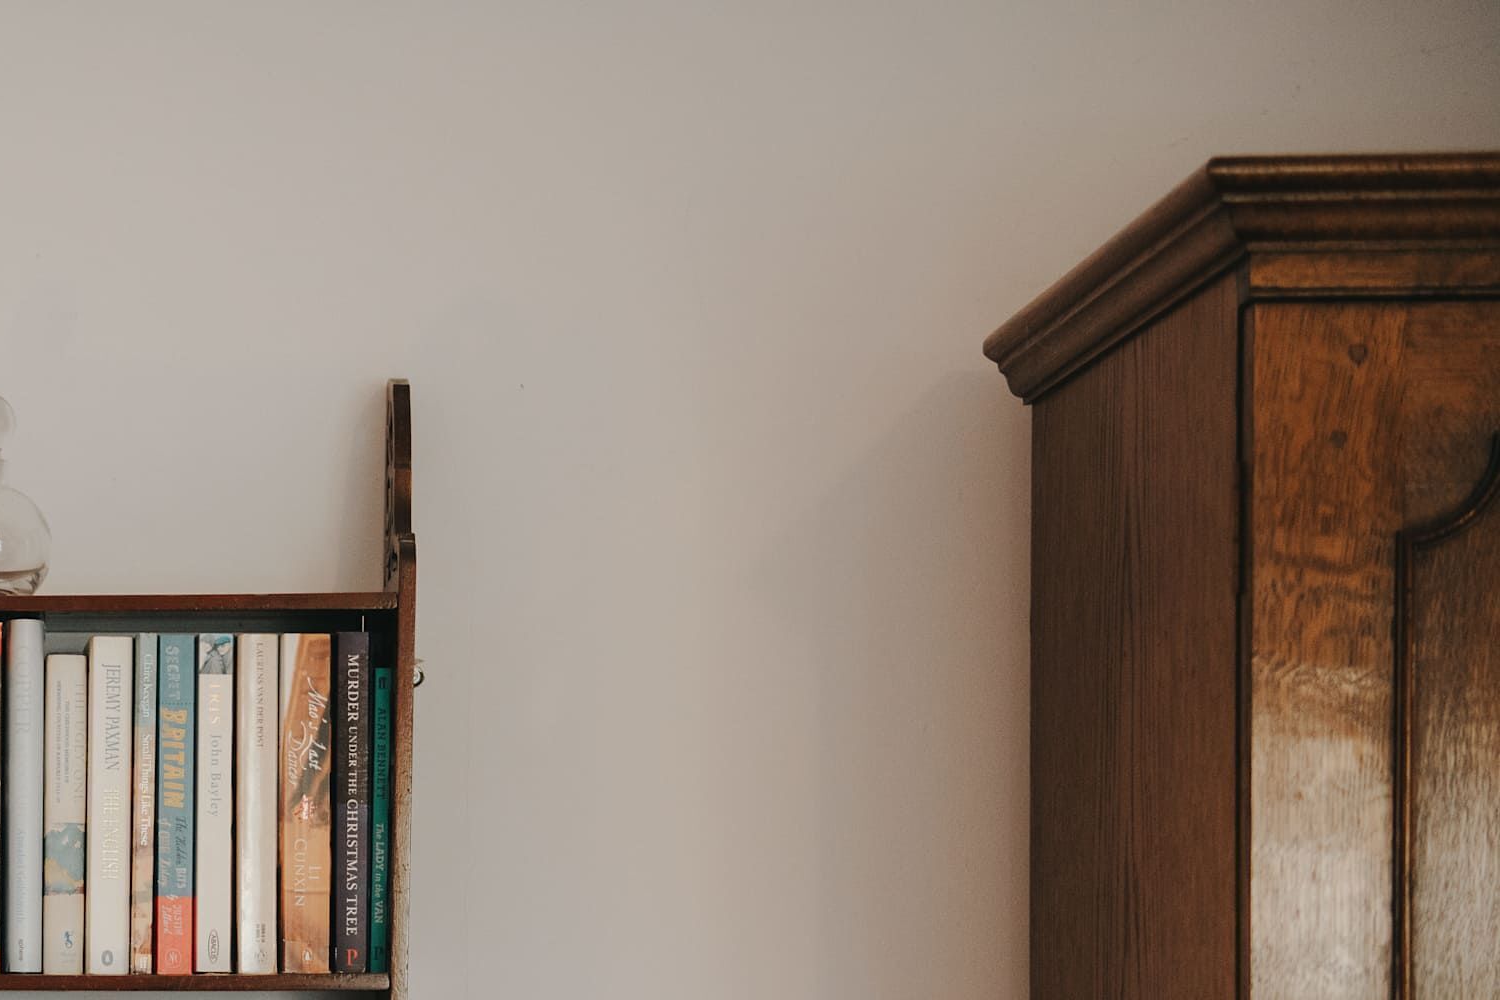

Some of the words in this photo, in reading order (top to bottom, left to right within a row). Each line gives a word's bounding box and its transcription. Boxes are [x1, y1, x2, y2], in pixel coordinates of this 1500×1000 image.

[143, 654, 153, 683] Claire
[165, 646, 181, 702] SECRET
[256, 642, 264, 685] LAURENS
[101, 664, 121, 712] JEREMY
[140, 684, 152, 718] Keegan
[256, 687, 264, 704] VAN
[307, 677, 328, 732] Mao's
[346, 654, 360, 721] MURDER
[255, 725, 263, 748] POST
[376, 708, 387, 740] ALAN
[104, 716, 119, 770] PAXMAN
[141, 734, 153, 761] Small
[161, 709, 188, 809] BRITAIN
[208, 734, 222, 768] John
[287, 731, 308, 787] Dancer
[308, 736, 325, 770] Last
[348, 725, 358, 768] UNDER
[140, 761, 152, 794] Things
[347, 770, 358, 795] THE
[376, 744, 388, 801] BENNETT
[103, 788, 119, 814] THE
[141, 795, 151, 815] Like
[206, 773, 222, 817] Bayley
[101, 818, 119, 879] ENGLISH
[140, 816, 151, 847] These
[346, 799, 360, 890] CHRISTMAS
[374, 823, 384, 840] The
[293, 839, 307, 907] CUNXIN
[374, 842, 384, 872] LADY
[374, 873, 383, 882] in
[374, 884, 383, 898] the
[346, 895, 358, 936] TREE
[373, 900, 383, 924] VAN
[17, 939, 26, 961] sphere
